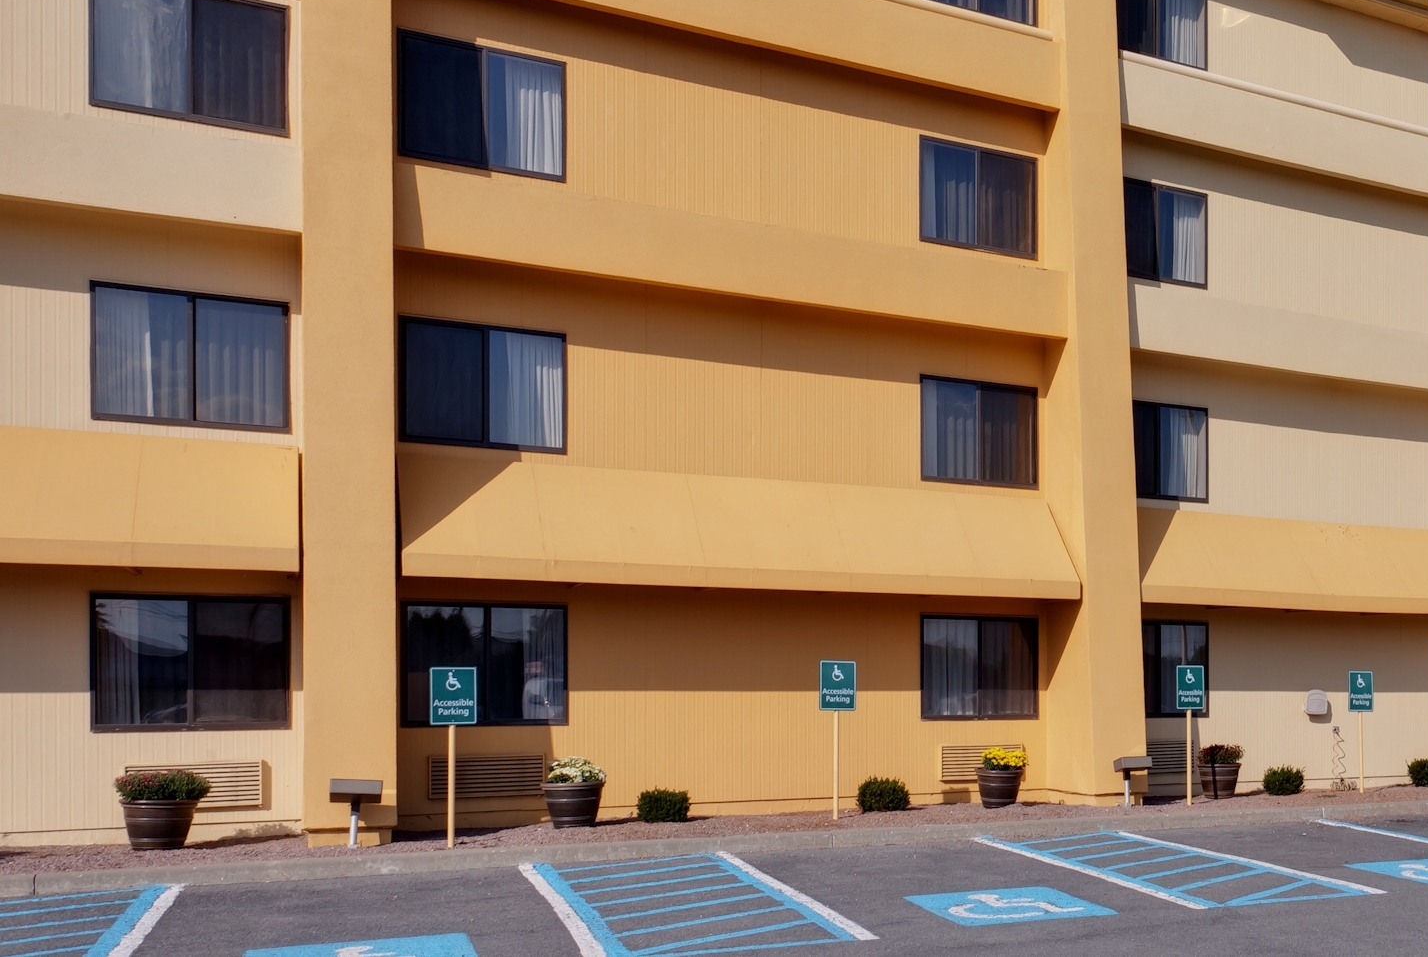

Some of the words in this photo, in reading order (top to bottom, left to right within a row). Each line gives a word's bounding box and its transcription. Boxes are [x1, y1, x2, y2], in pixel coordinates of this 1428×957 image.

[433, 698, 474, 707] Accessible
[825, 695, 850, 704] Parking
[1352, 699, 1370, 707] Parking
[438, 707, 469, 717] Parking
